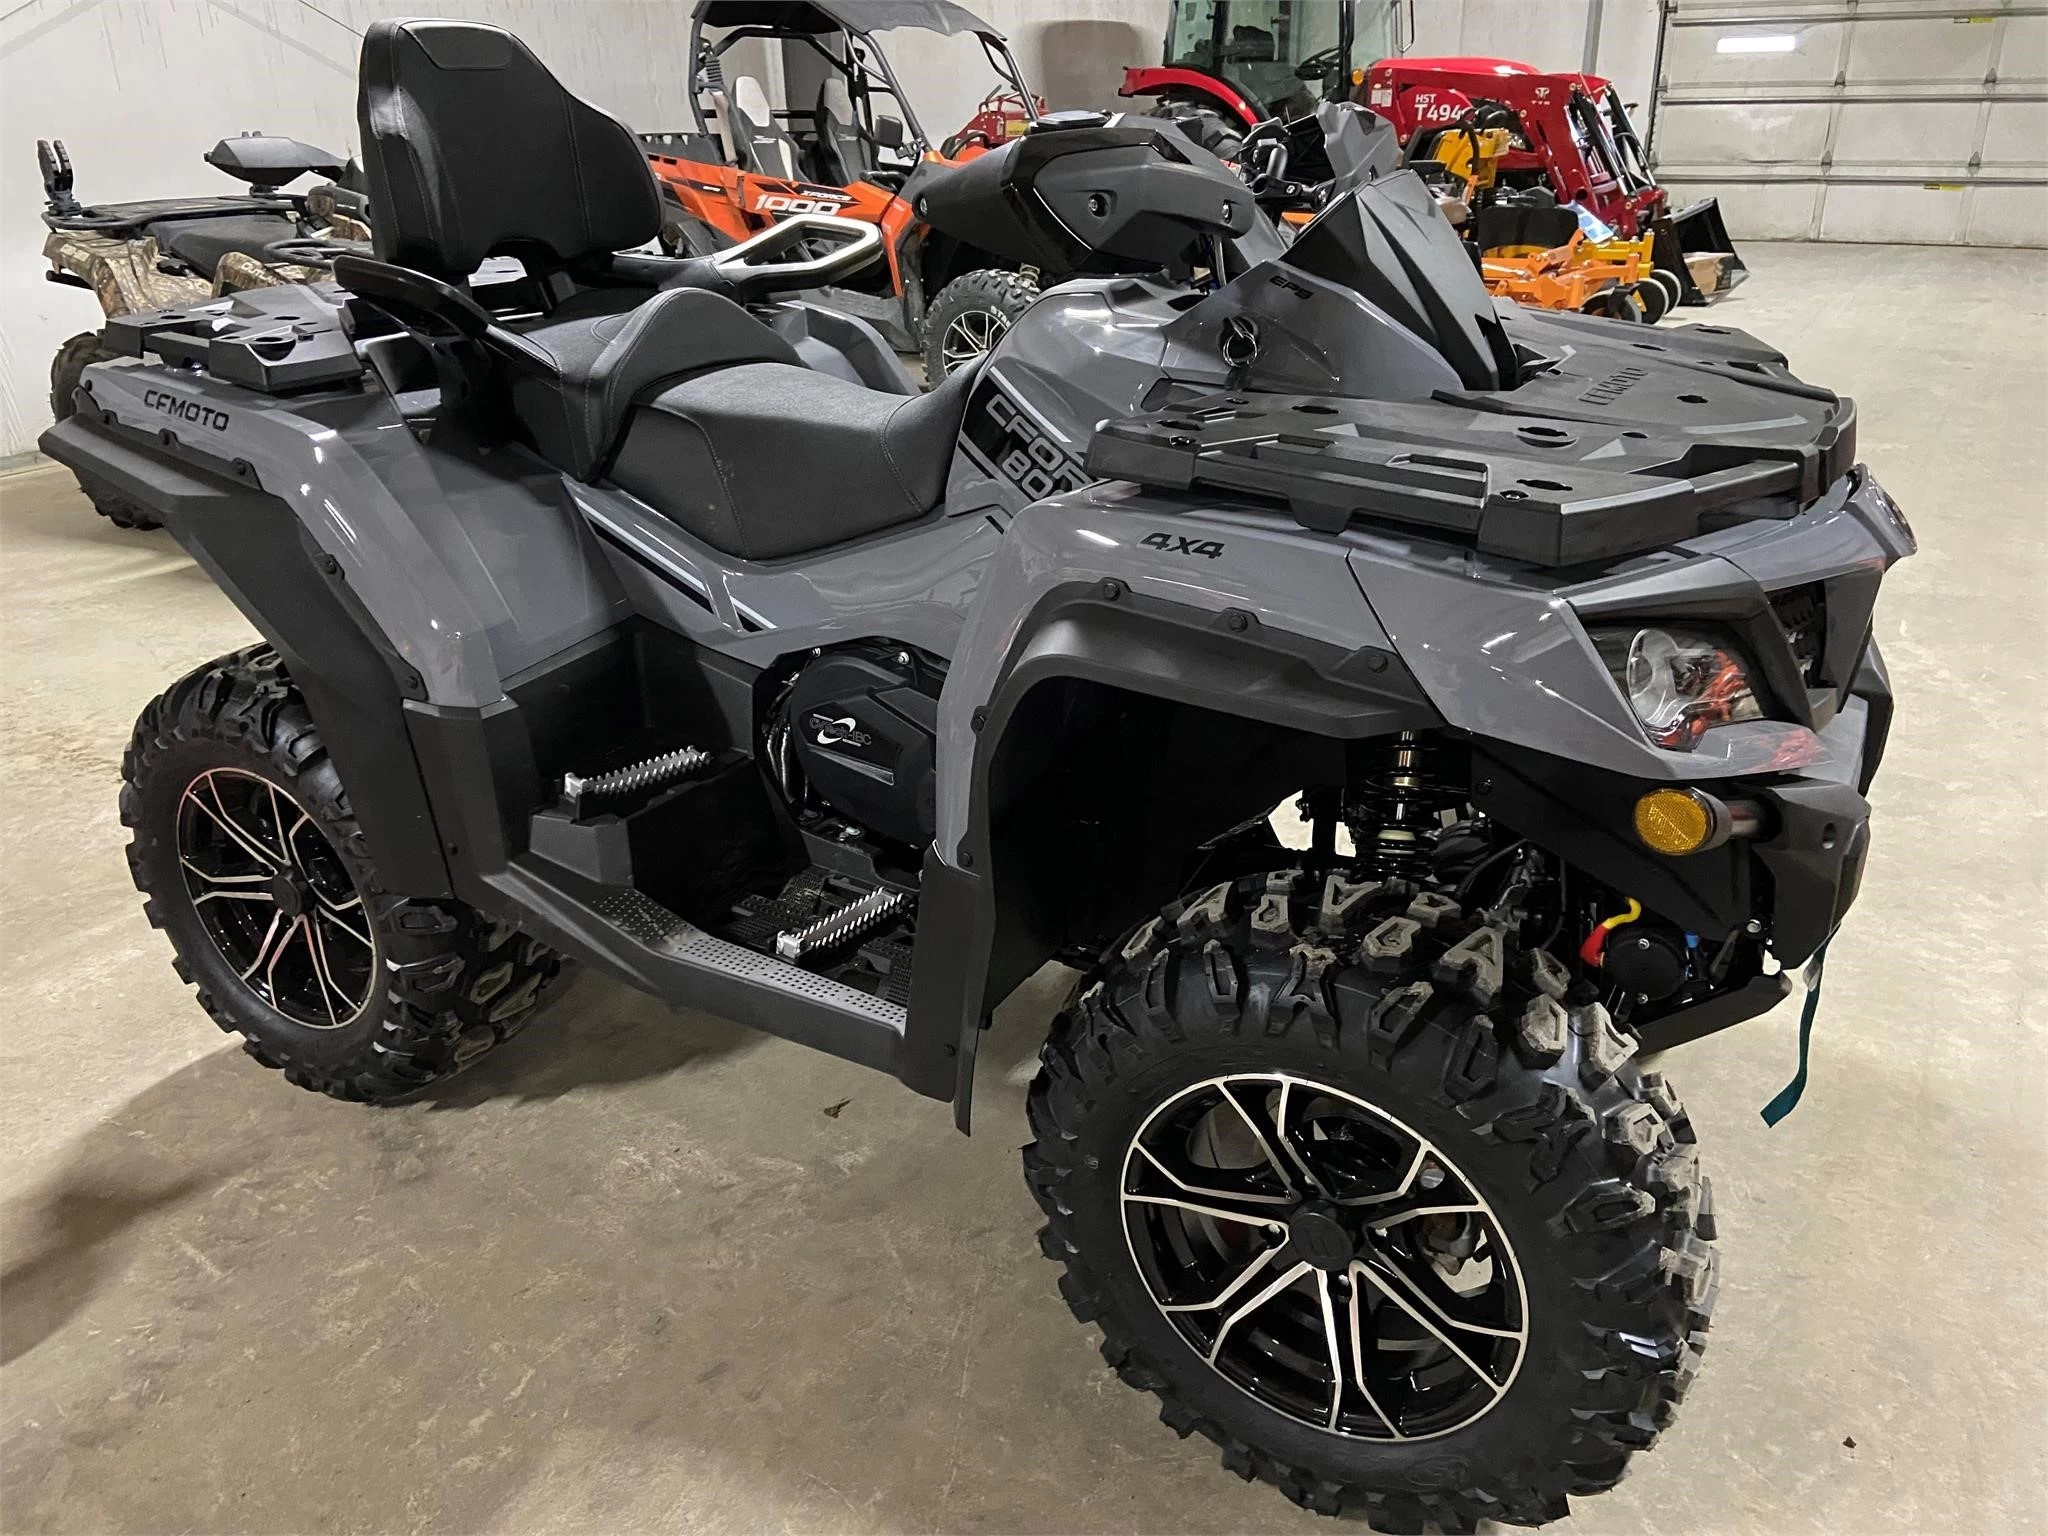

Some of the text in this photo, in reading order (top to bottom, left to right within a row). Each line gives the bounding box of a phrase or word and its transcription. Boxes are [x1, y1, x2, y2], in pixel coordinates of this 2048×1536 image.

[1415, 94, 1437, 104] HST
[1414, 104, 1461, 122] T494
[755, 194, 841, 216] 1000
[1269, 275, 1314, 300] EPS
[144, 389, 229, 431] CFMOTO
[1002, 449, 1066, 500] 80
[1140, 532, 1225, 559] 4X4
